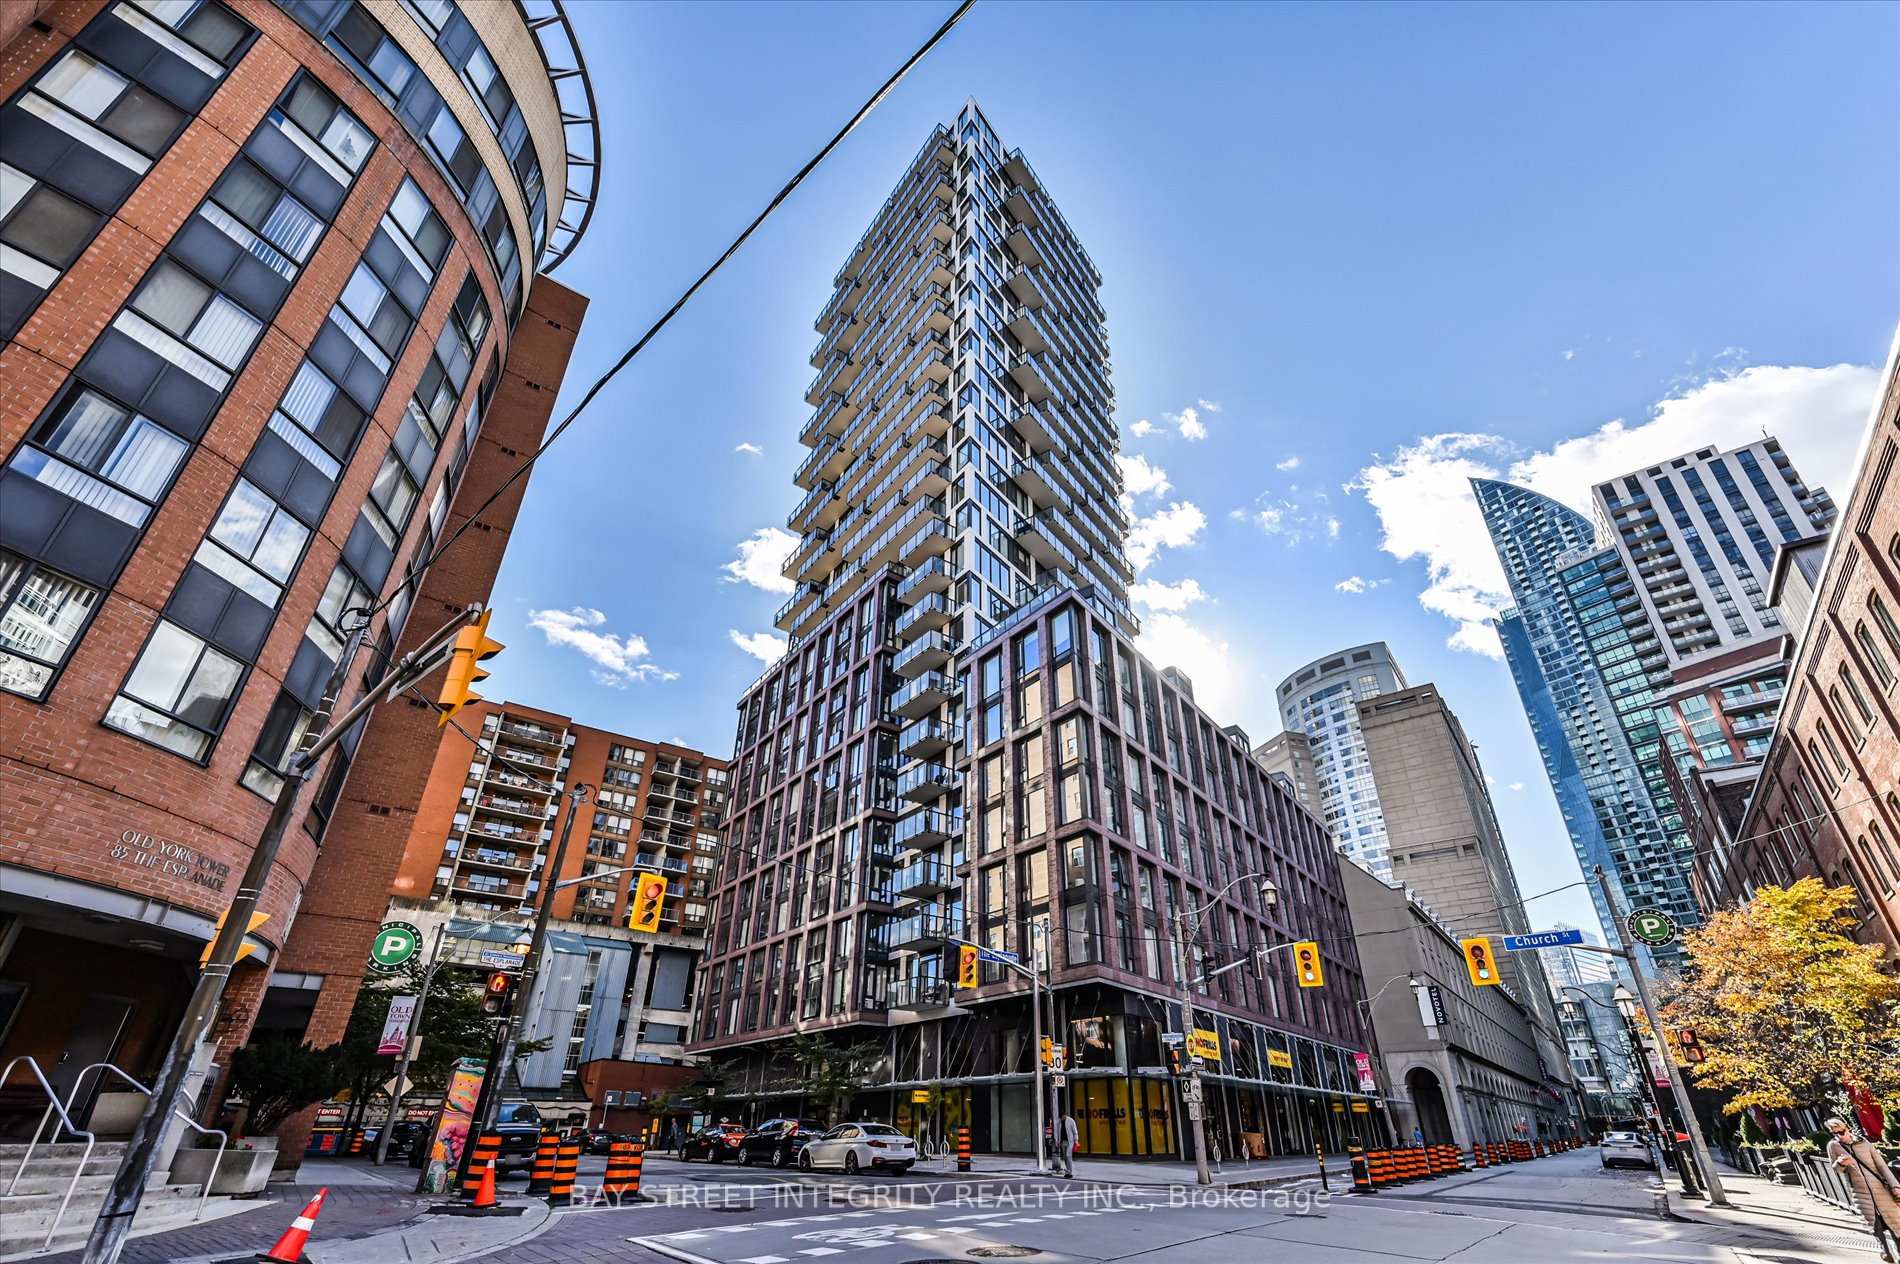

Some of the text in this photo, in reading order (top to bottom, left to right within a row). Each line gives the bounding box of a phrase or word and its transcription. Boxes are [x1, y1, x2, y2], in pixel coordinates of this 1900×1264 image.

[110, 843, 130, 860] 85
[133, 849, 161, 869] THE
[122, 829, 231, 878] OLD YORK TOWER
[1640, 918, 1661, 935] P
[380, 935, 407, 957] P
[1515, 933, 1559, 947] Church
[390, 1006, 414, 1014] OLD
[1430, 986, 1445, 1024] NOVOTEL
